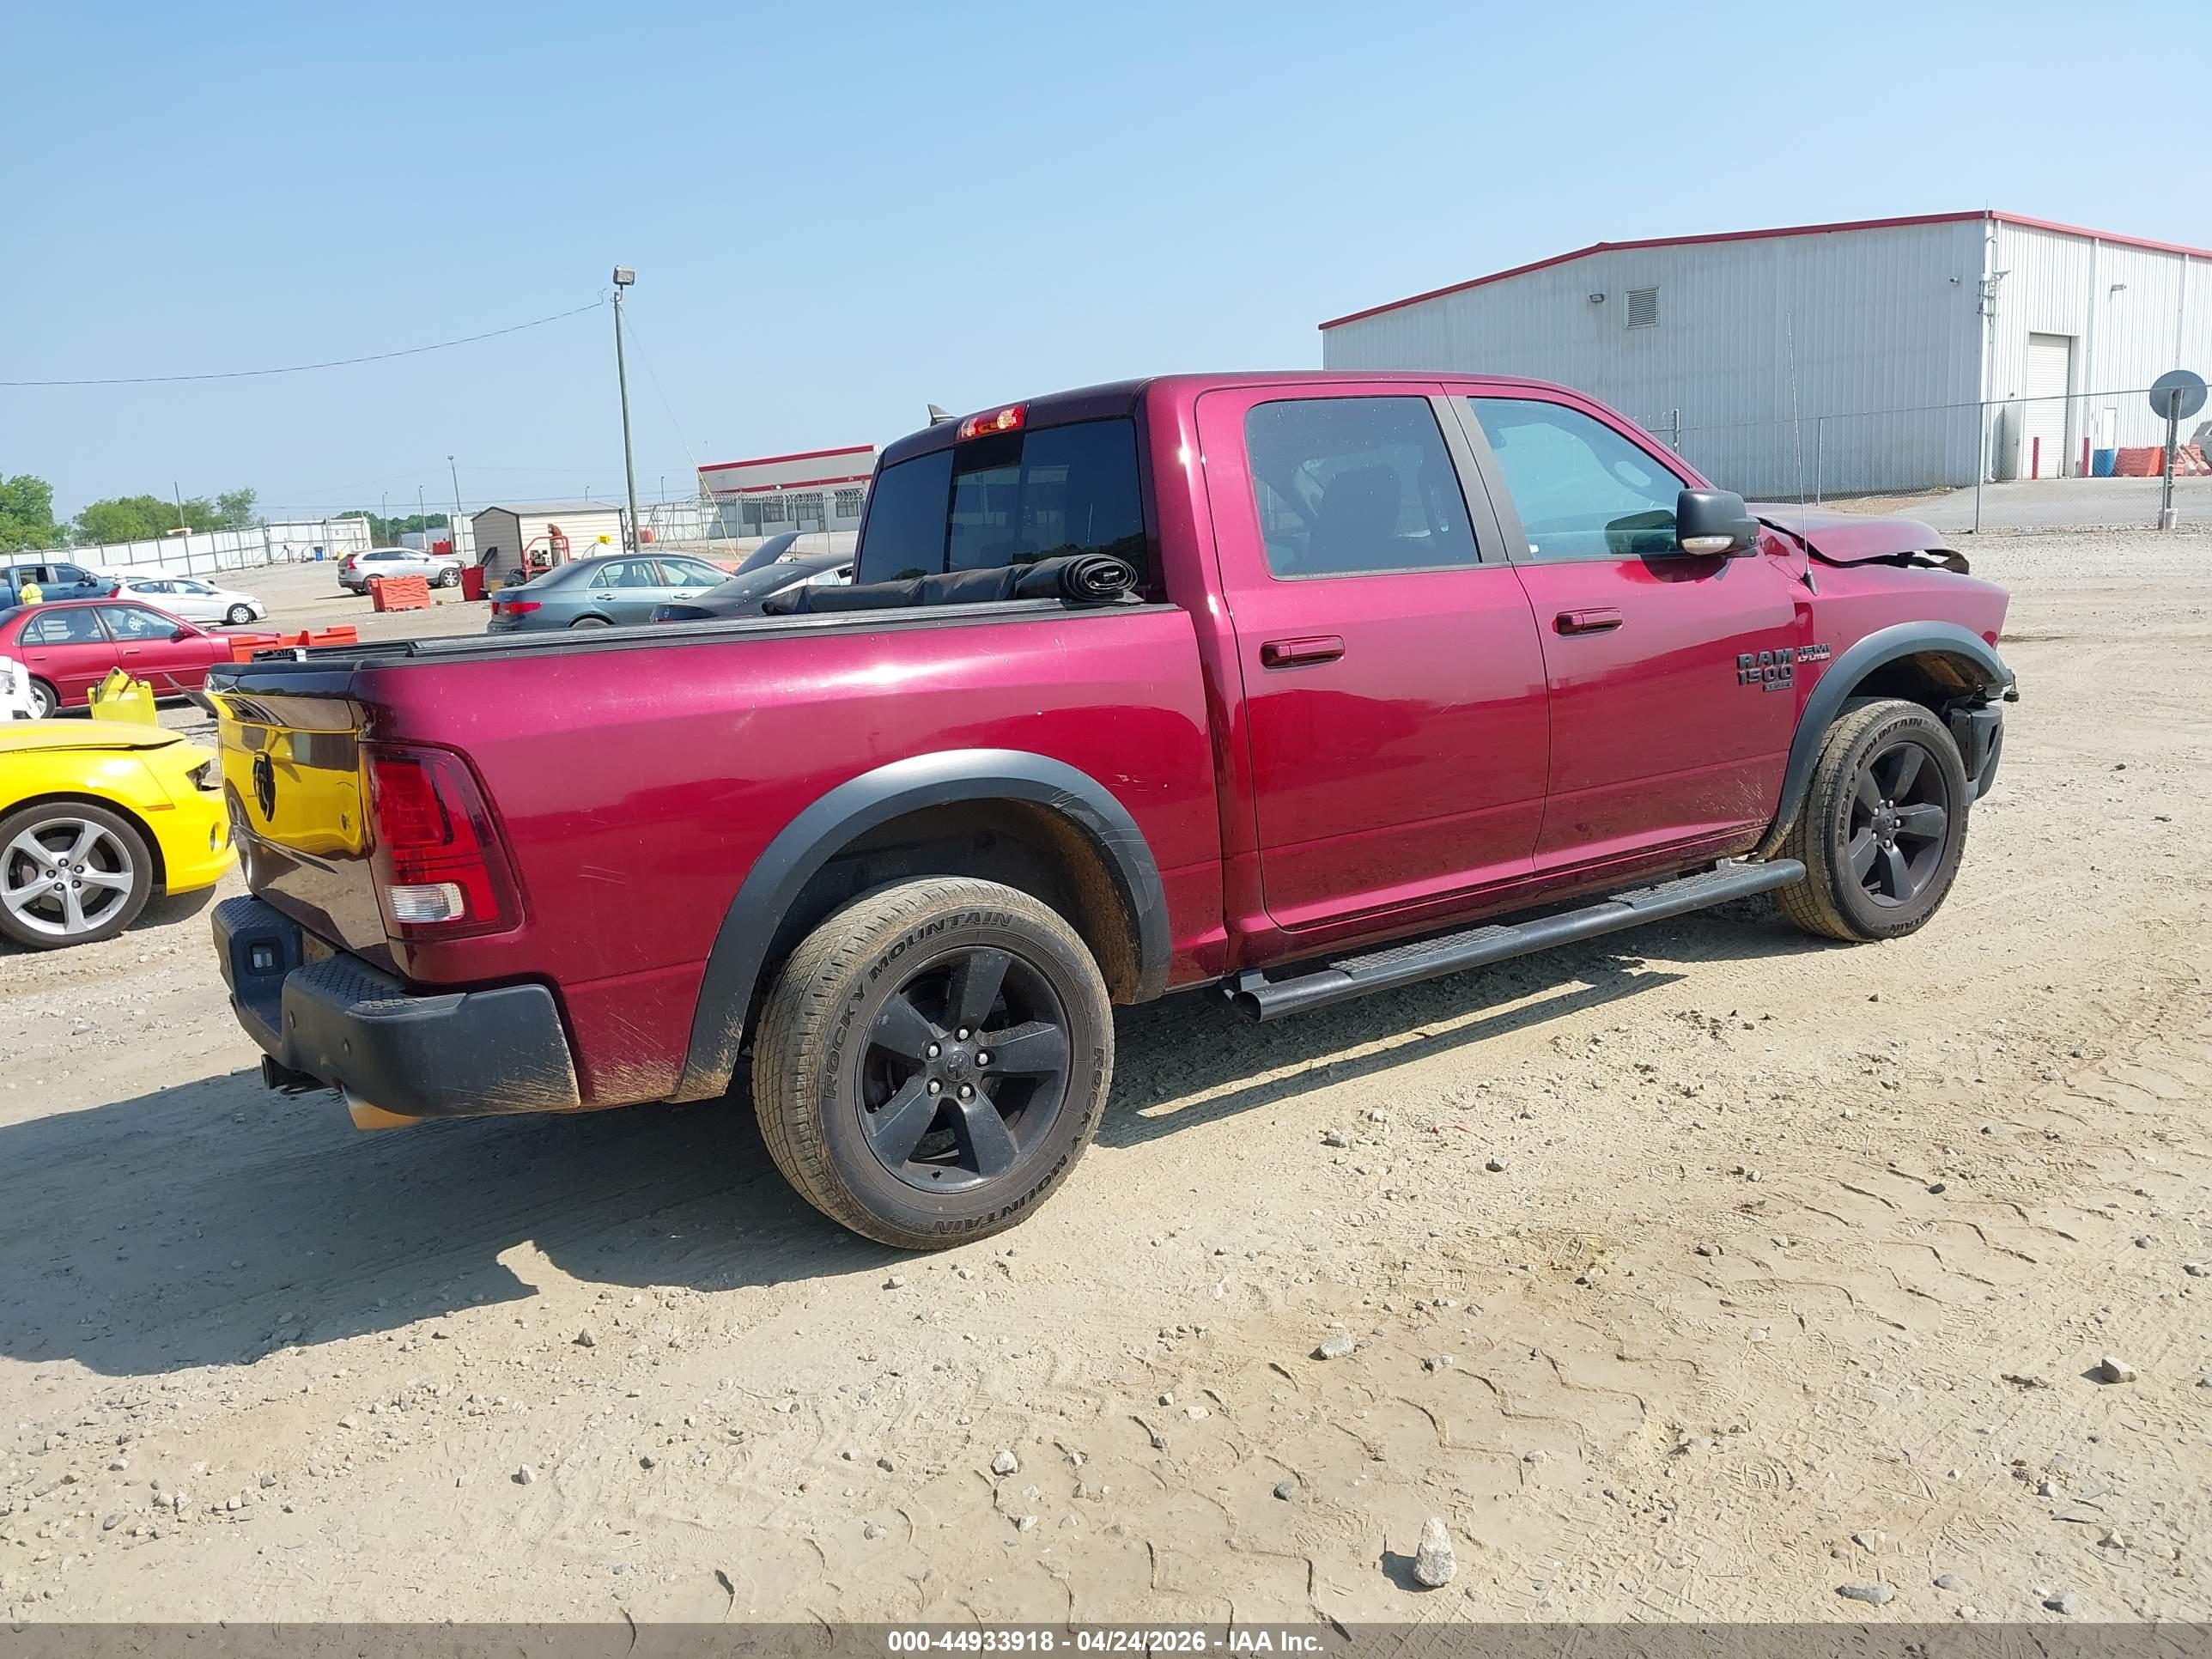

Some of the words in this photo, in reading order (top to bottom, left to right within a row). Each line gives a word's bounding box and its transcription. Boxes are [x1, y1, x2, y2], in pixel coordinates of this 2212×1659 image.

[1737, 647, 1794, 670] RAM
[1737, 664, 1794, 686] 1500
[1856, 718, 1923, 770] MOUNTAIN
[823, 982, 867, 1100] ROCKY
[869, 910, 1015, 983] MOUNTAIN
[1070, 1047, 1106, 1152] ROCKY
[929, 1153, 1068, 1235] MOUNTAIN
